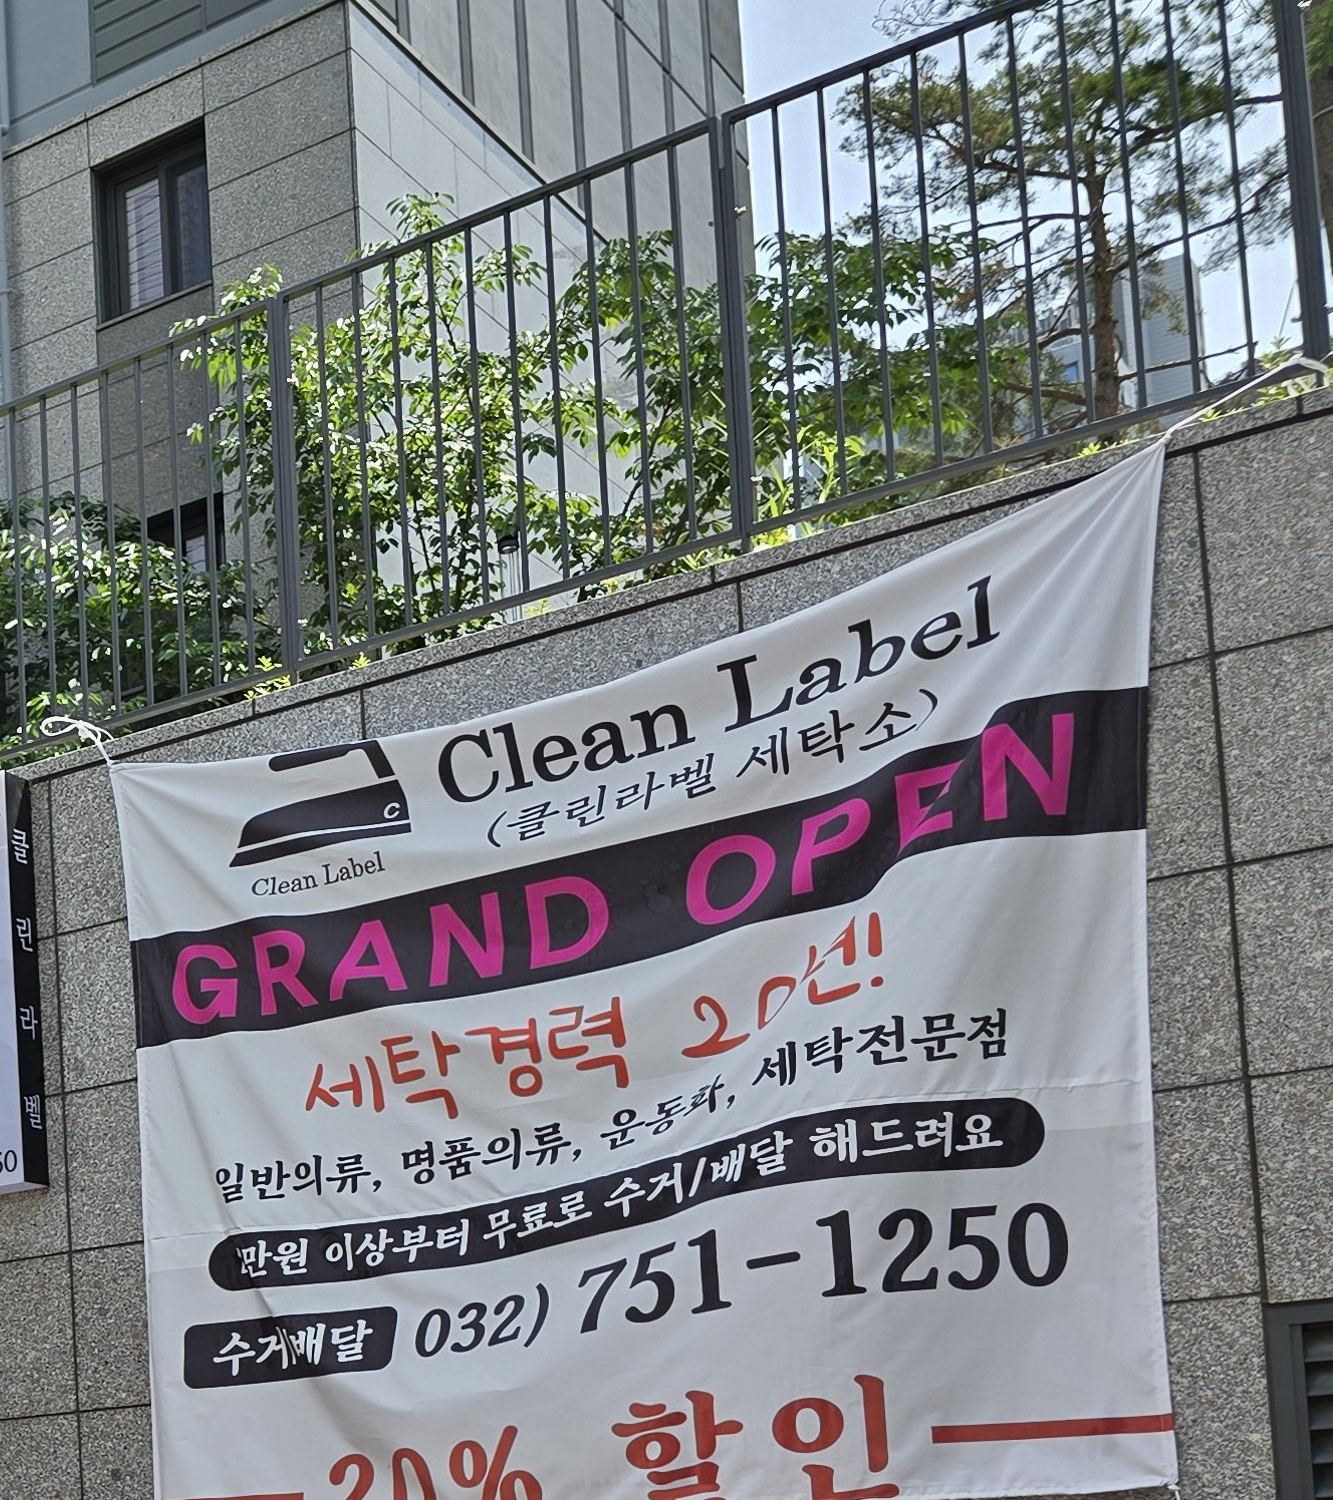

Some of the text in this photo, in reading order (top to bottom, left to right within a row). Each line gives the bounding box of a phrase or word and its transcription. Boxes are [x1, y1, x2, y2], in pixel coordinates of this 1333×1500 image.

[437, 575, 1000, 804] Clean Label
[172, 713, 1075, 1025] GRAND OPEN
[251, 850, 385, 898] Clean Label
[215, 1153, 382, 1205] 일반의류,
[401, 1122, 583, 1186] 명품의류,
[751, 1006, 1008, 1087] 세탁전문점
[236, 1110, 1004, 1279] 만원 이상부터 무료로 수거/배달 해드려요
[212, 1202, 1069, 1377] 수거배달 032) 751-1250
